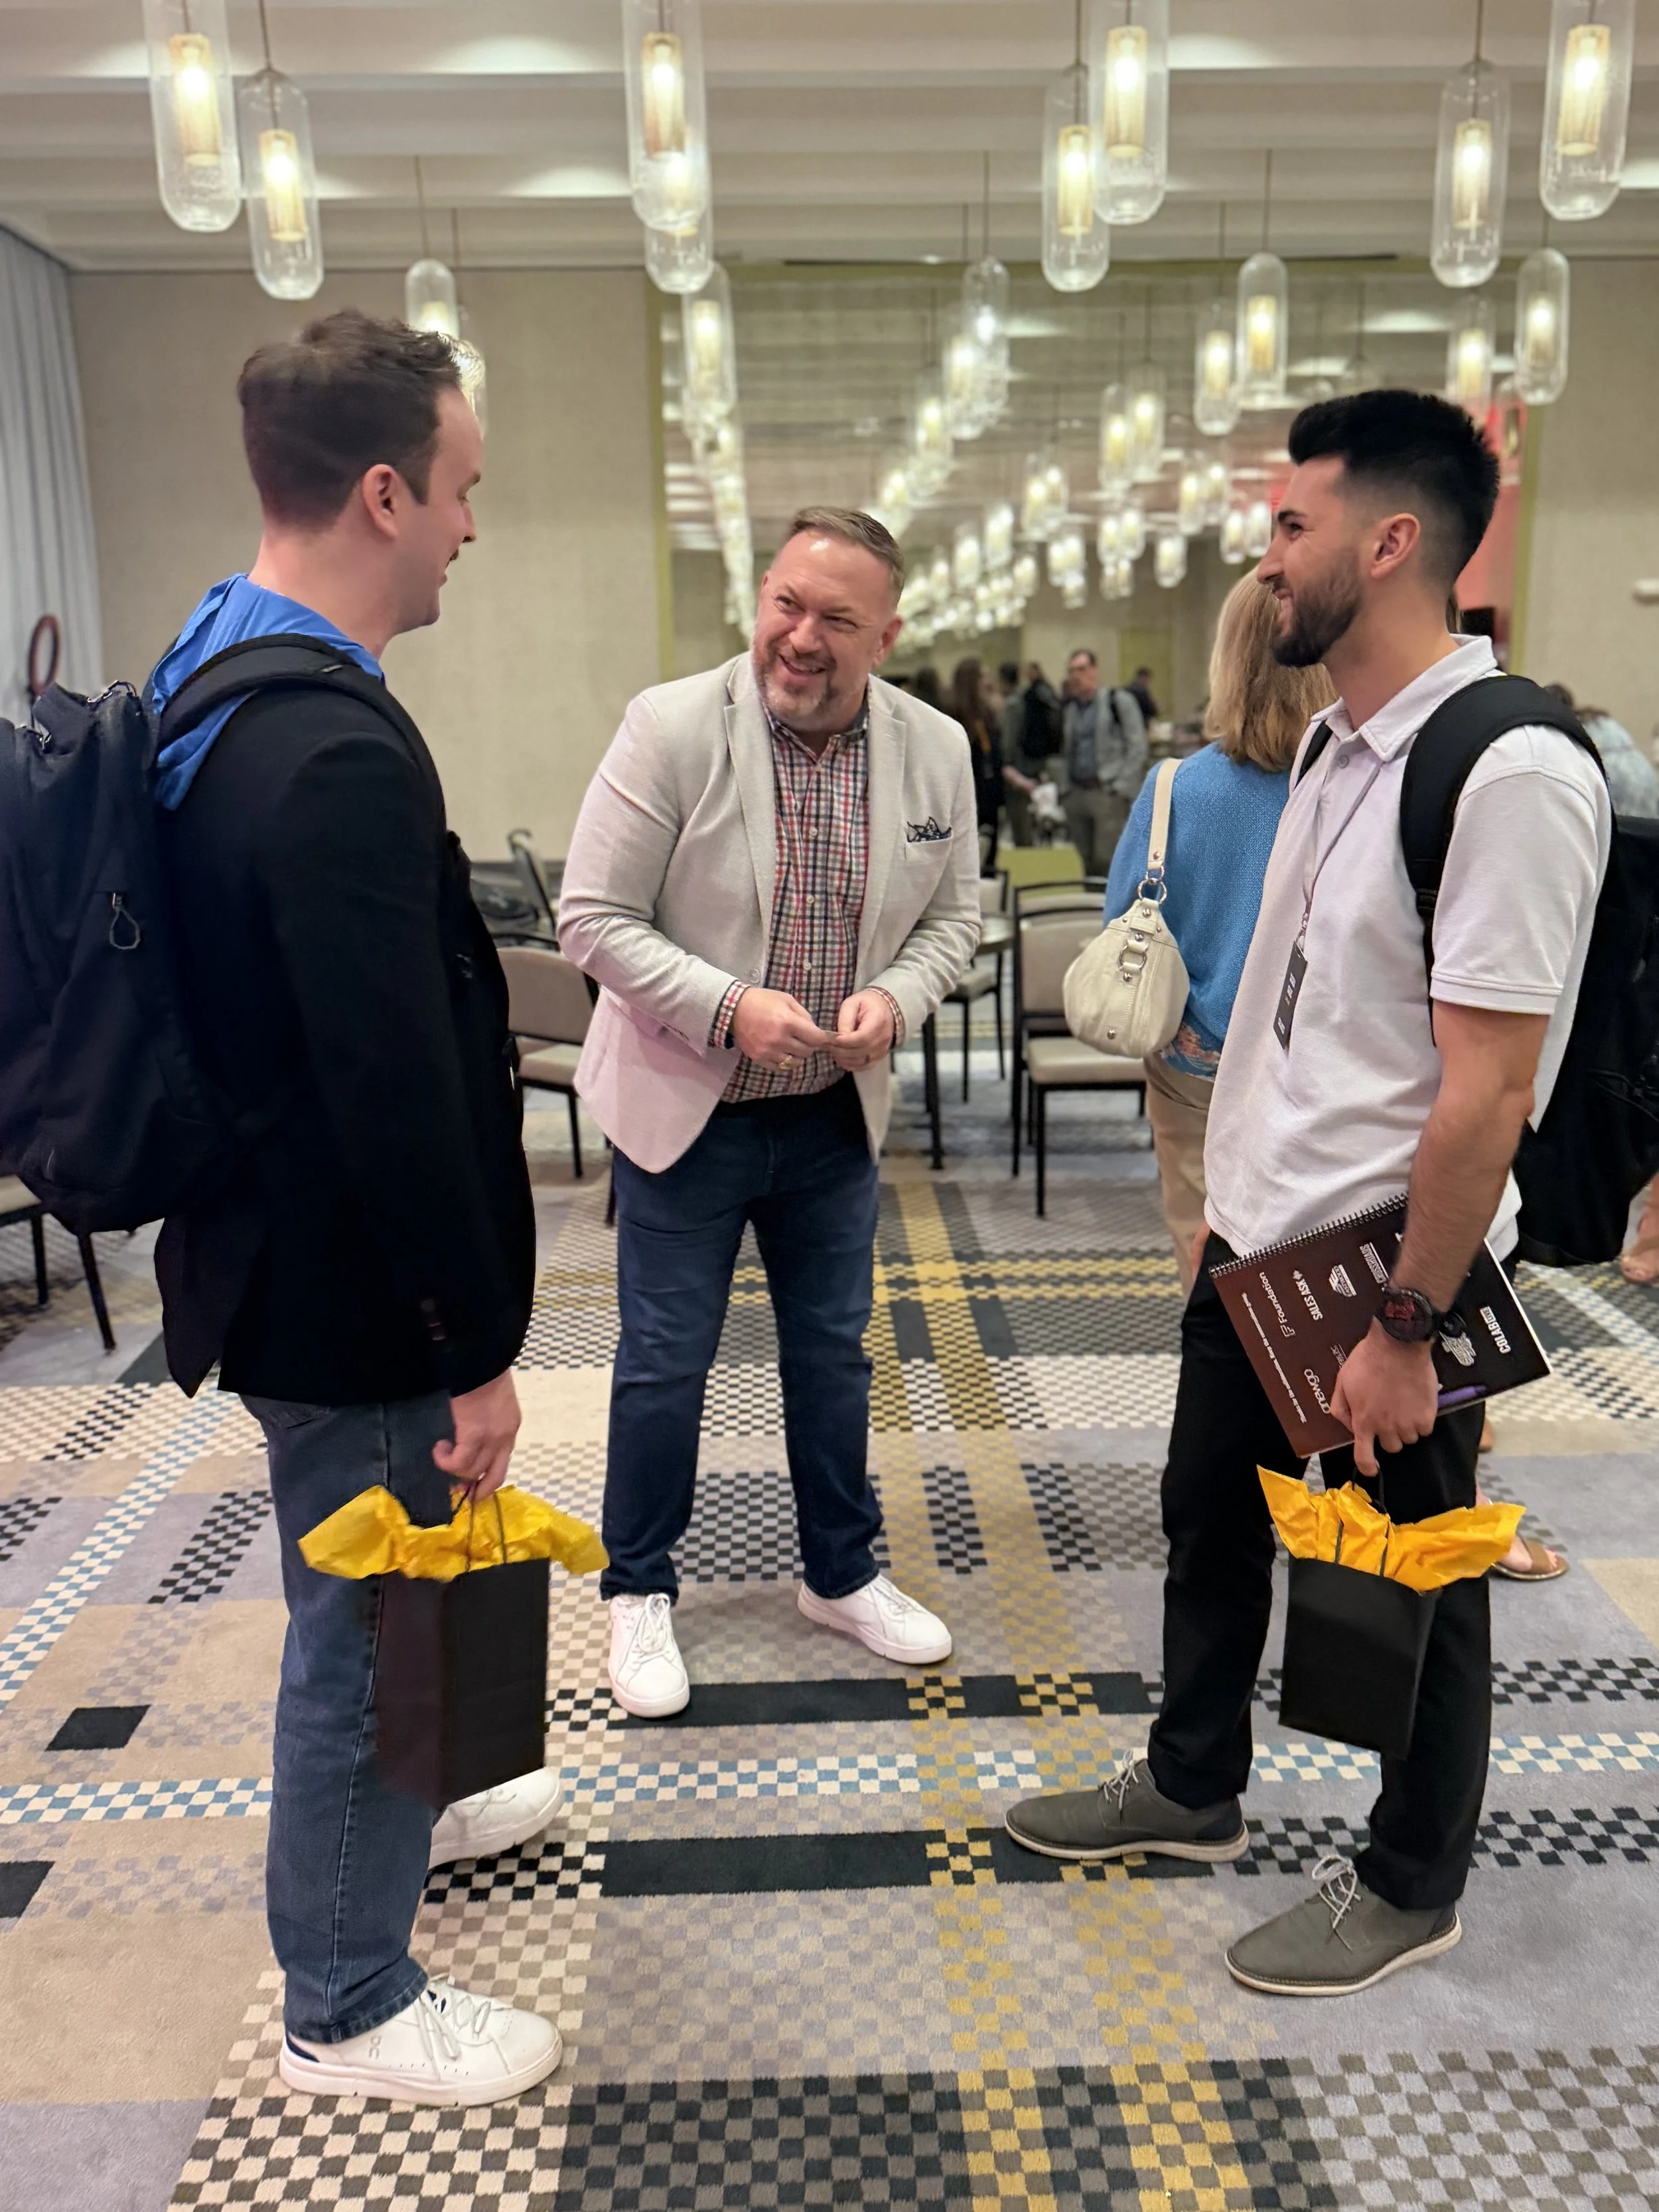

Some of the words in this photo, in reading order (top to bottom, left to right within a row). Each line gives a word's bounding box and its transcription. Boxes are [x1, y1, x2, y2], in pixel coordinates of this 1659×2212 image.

[1296, 1279, 1311, 1295] ASK
[1334, 1266, 1352, 1297] EASTWOOD
[1260, 1272, 1287, 1323] Foundation
[1304, 1295, 1323, 1320] SALES
[1488, 1321, 1510, 1353] COLAB
[1304, 1368, 1331, 1414] anewgo
